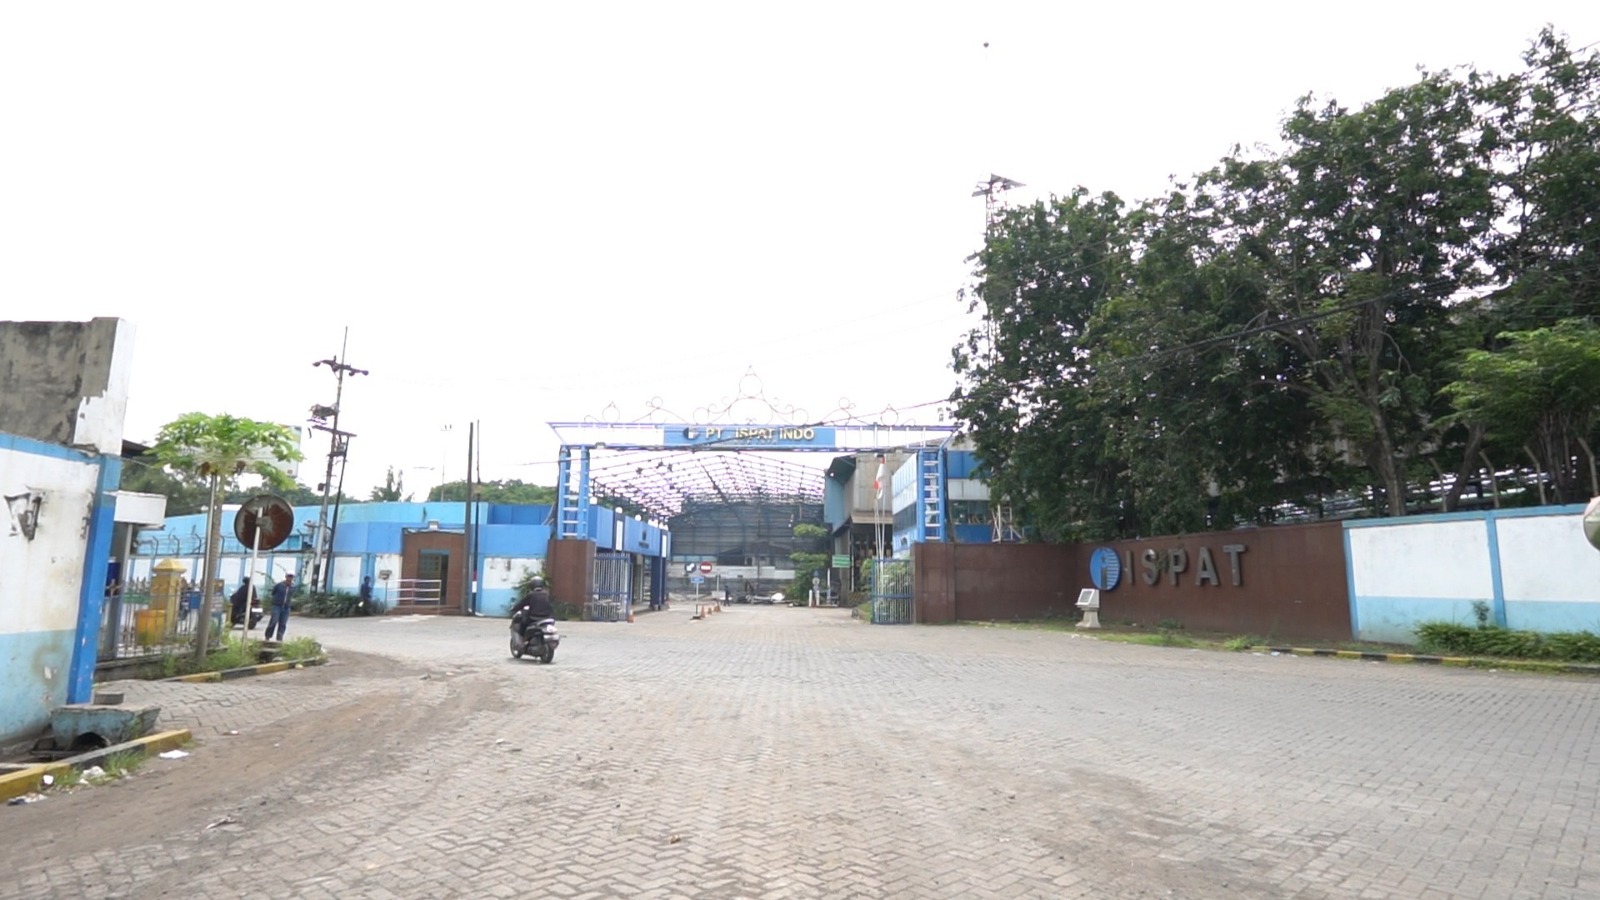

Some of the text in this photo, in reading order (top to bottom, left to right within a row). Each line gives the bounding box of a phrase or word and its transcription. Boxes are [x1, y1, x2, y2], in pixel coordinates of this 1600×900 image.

[705, 427, 815, 441] PT ISPAT INDO
[1123, 543, 1246, 587] ISPAT
